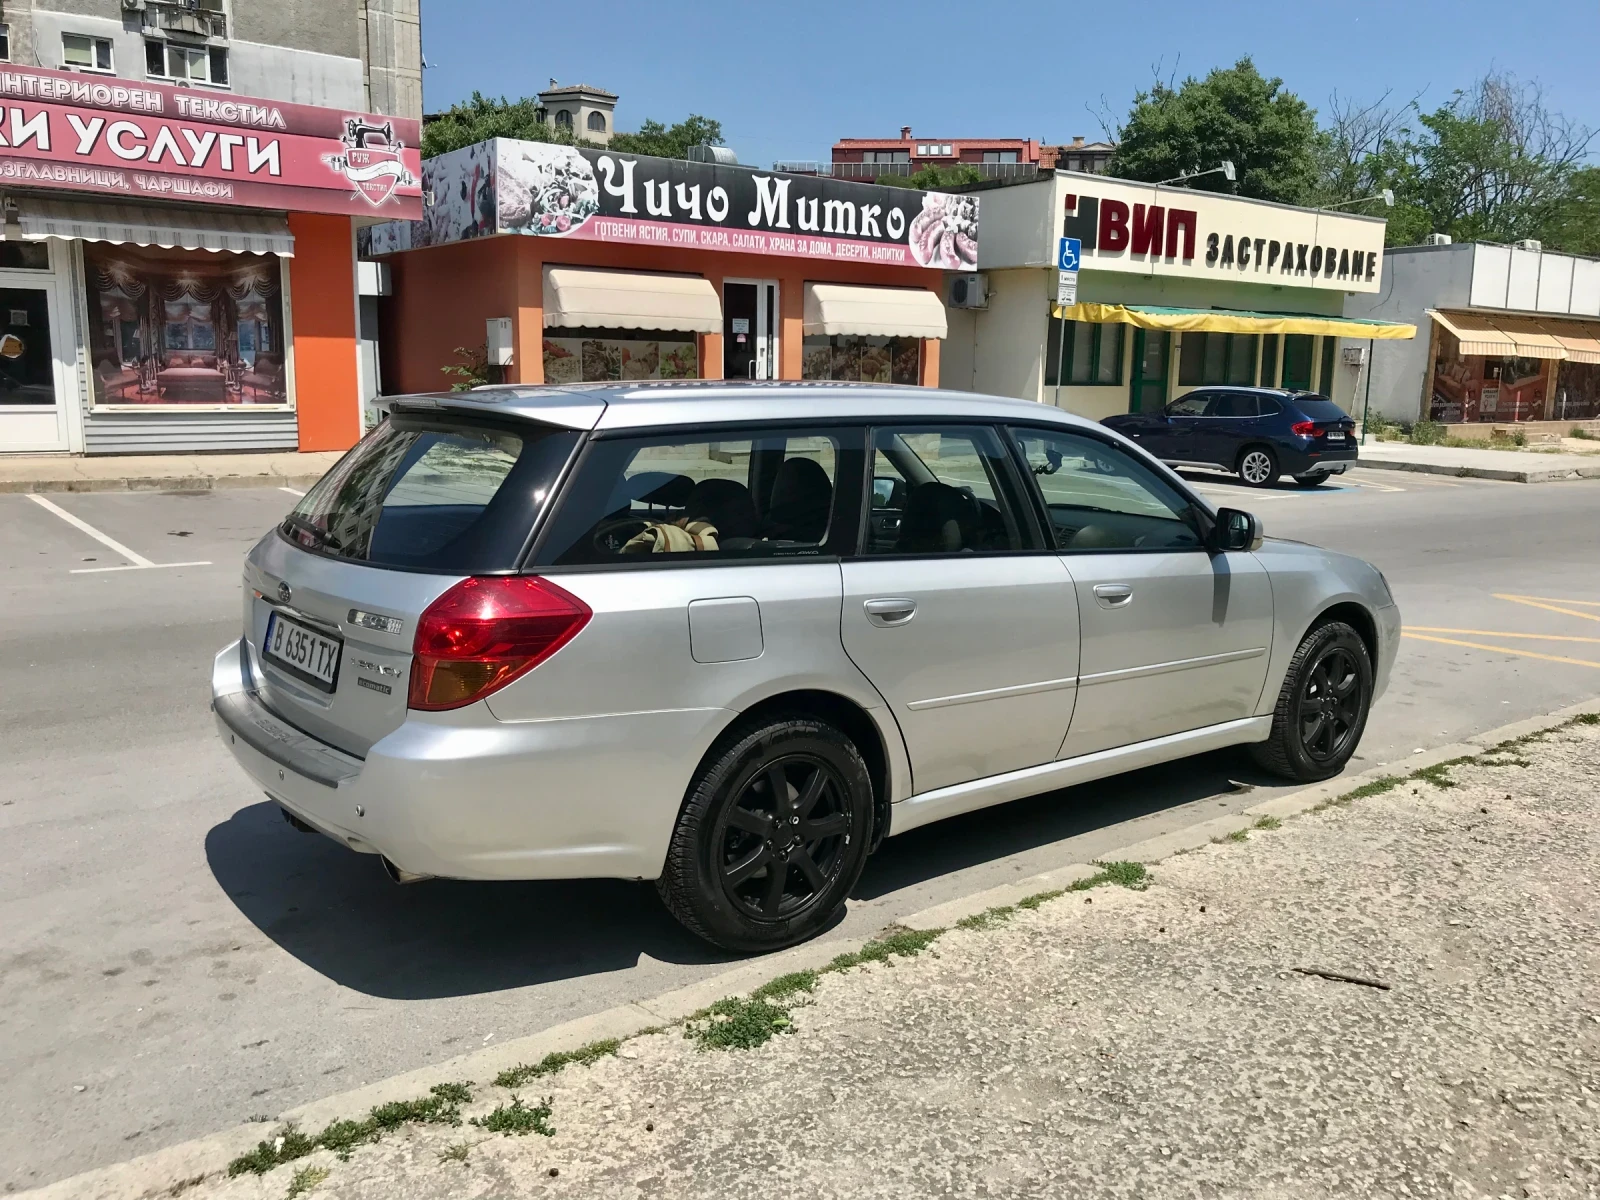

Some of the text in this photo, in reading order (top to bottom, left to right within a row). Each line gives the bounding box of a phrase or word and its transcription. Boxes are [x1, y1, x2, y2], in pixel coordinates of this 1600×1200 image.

[174, 94, 286, 128] ТЕКСТИЛ
[65, 114, 281, 177] УСЛУГИ
[0, 161, 234, 199] ЗГЛАВНИЦИ, ЧАРШАФИ
[597, 155, 905, 240] Чичо Митко
[594, 221, 905, 262] ГОТВЕНИ ЯСТИЯ, СУПИ, СКАРА, САЛАТИ, ХРАНА ЗА ДОМА, ДЕСЕРТИ, НАПИТКИ
[1098, 198, 1378, 278] ВИП ЗАСТРАХОВАНЕ
[273, 621, 337, 678] B 6351 TX
